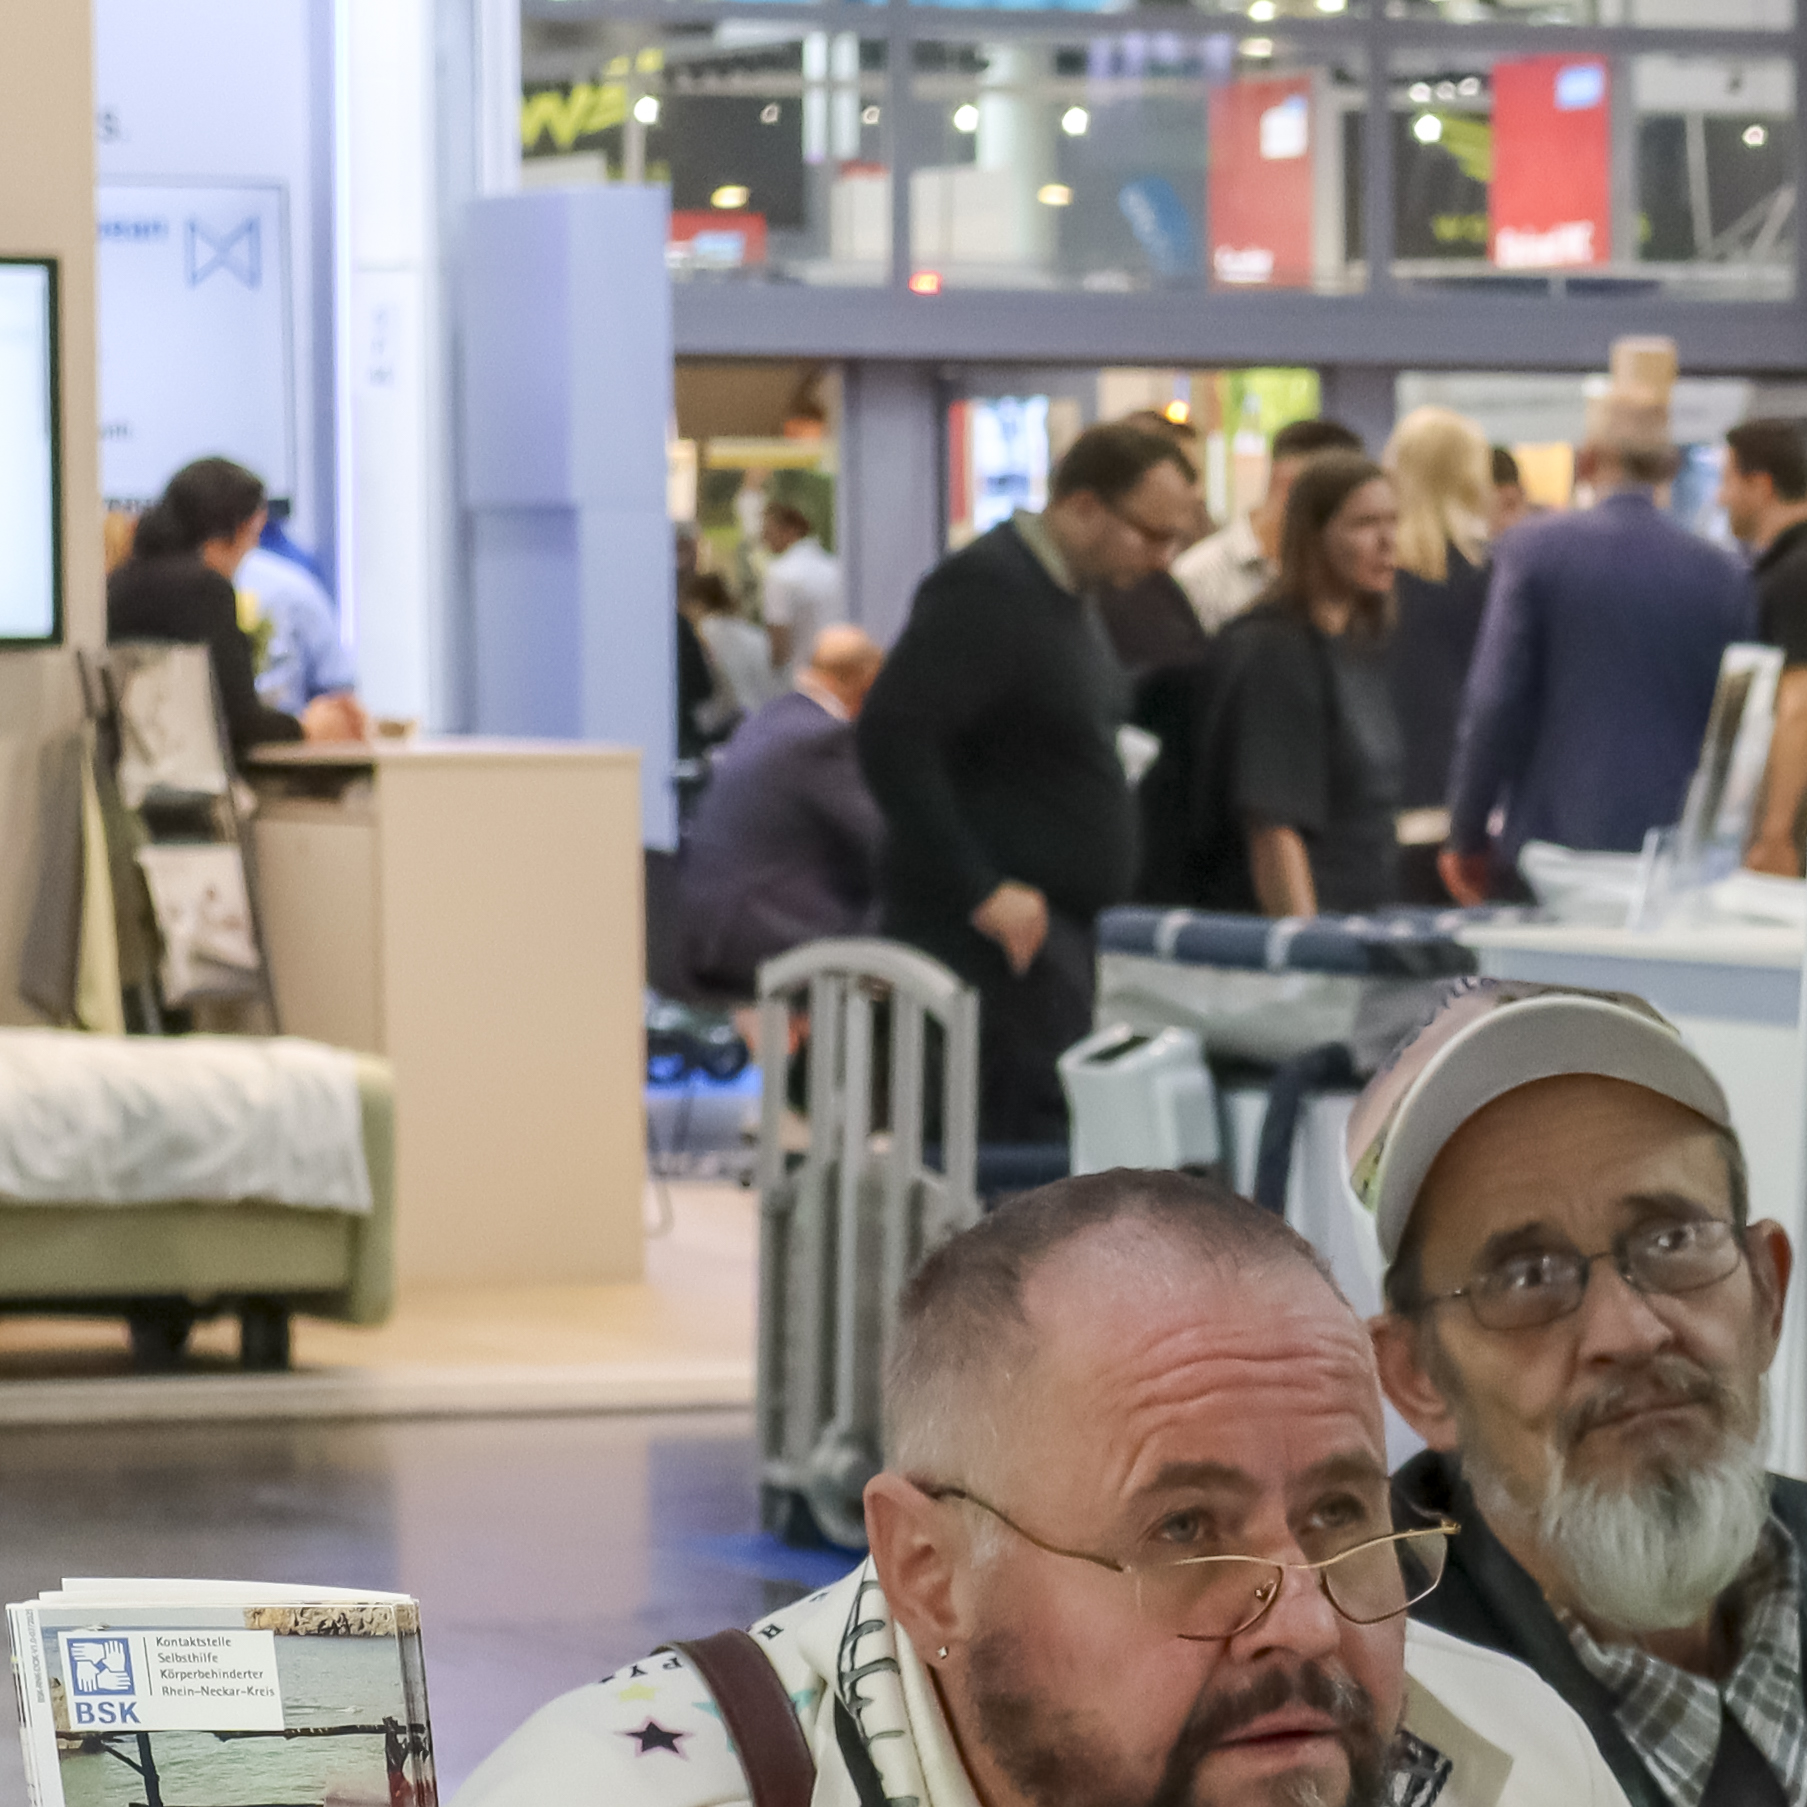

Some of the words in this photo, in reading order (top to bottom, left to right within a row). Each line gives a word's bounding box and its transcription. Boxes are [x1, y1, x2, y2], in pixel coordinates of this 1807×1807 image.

[155, 1635, 233, 1649] Kontaktstelle
[158, 1651, 219, 1664] Selbsthilfe
[160, 1668, 264, 1681] Körperbehinderter
[74, 1701, 142, 1725] BSK
